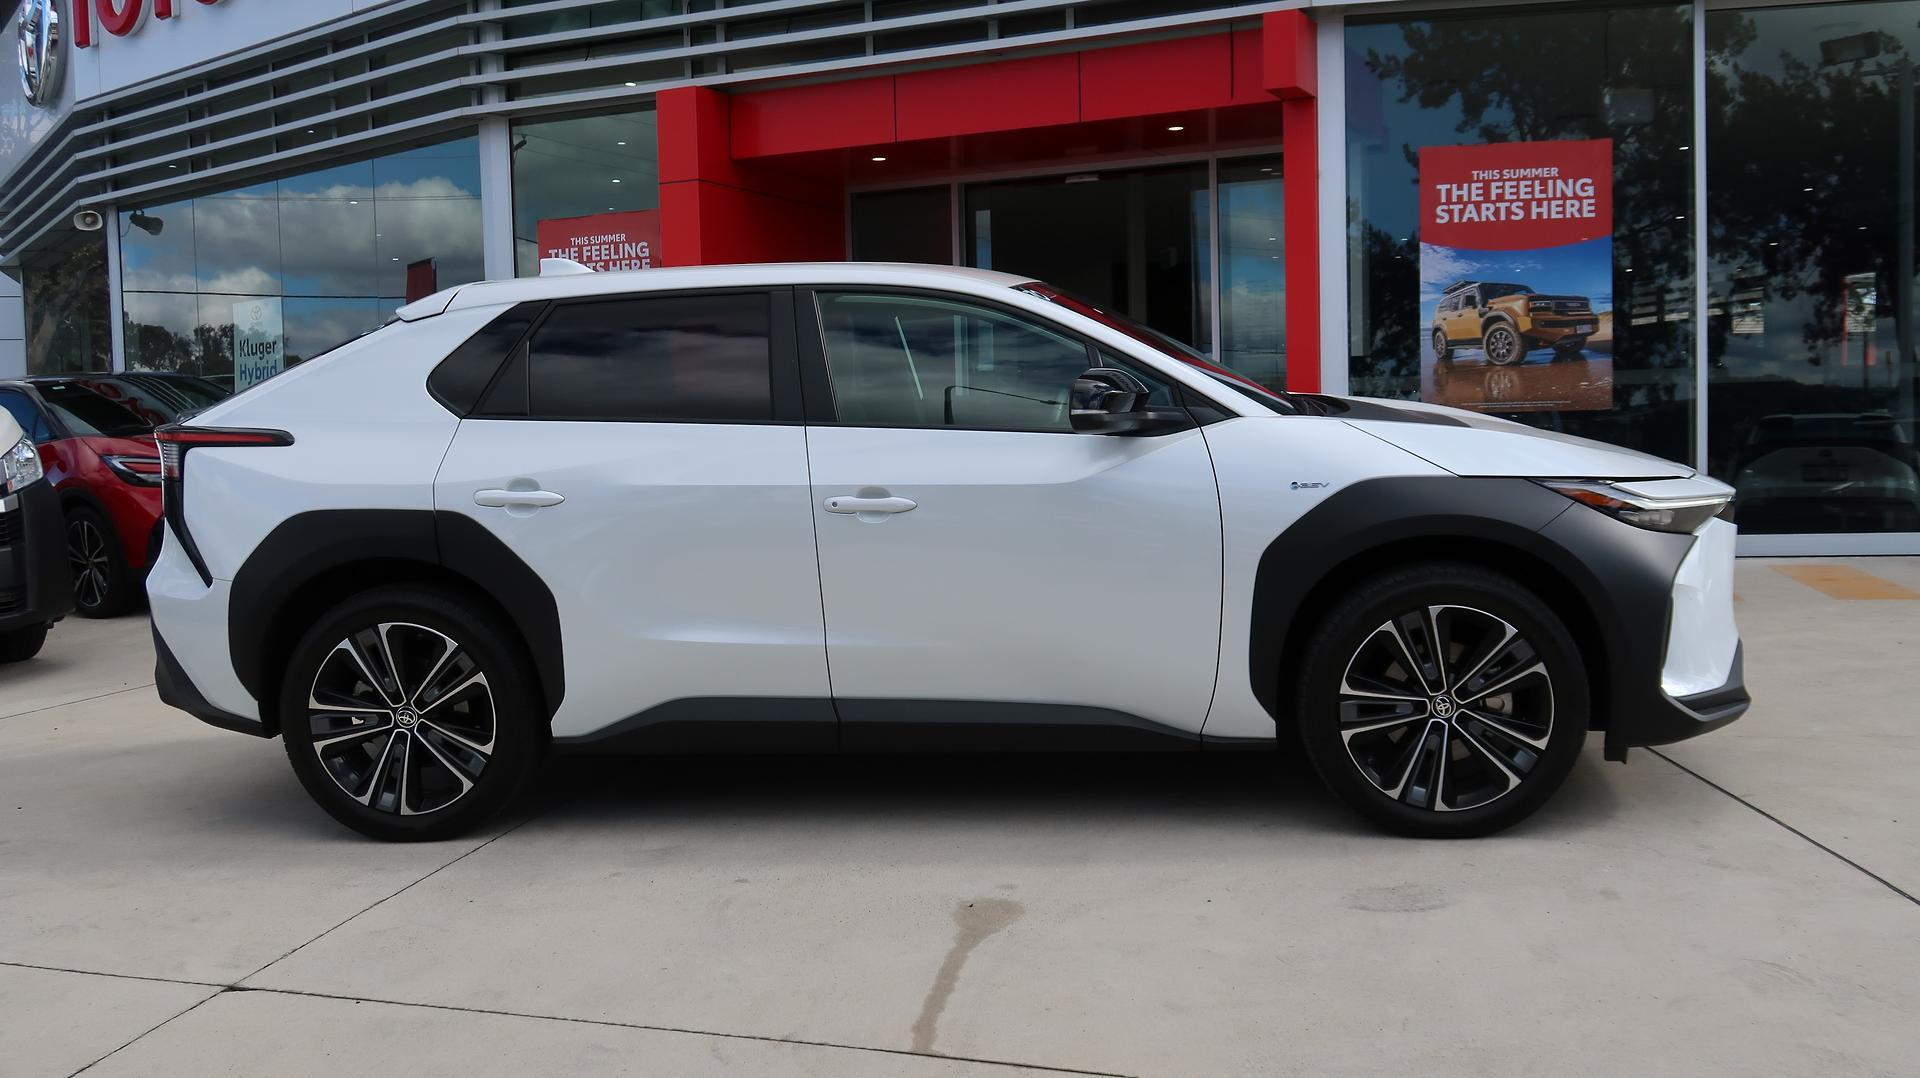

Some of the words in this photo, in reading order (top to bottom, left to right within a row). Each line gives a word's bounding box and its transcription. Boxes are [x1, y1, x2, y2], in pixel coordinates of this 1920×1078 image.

[1471, 170, 1500, 181] THIS
[1503, 167, 1559, 179] SUMMER
[1436, 183, 1484, 203] THE
[1490, 178, 1594, 201] FEELING
[1435, 202, 1525, 224] STARTS
[1531, 199, 1596, 219] HERE
[570, 237, 589, 246] THIS
[590, 234, 626, 244] SUMMER
[549, 248, 579, 260] THE
[582, 242, 650, 261] FEELING
[240, 339, 277, 360] Kluger
[240, 360, 277, 385] Hybrid
